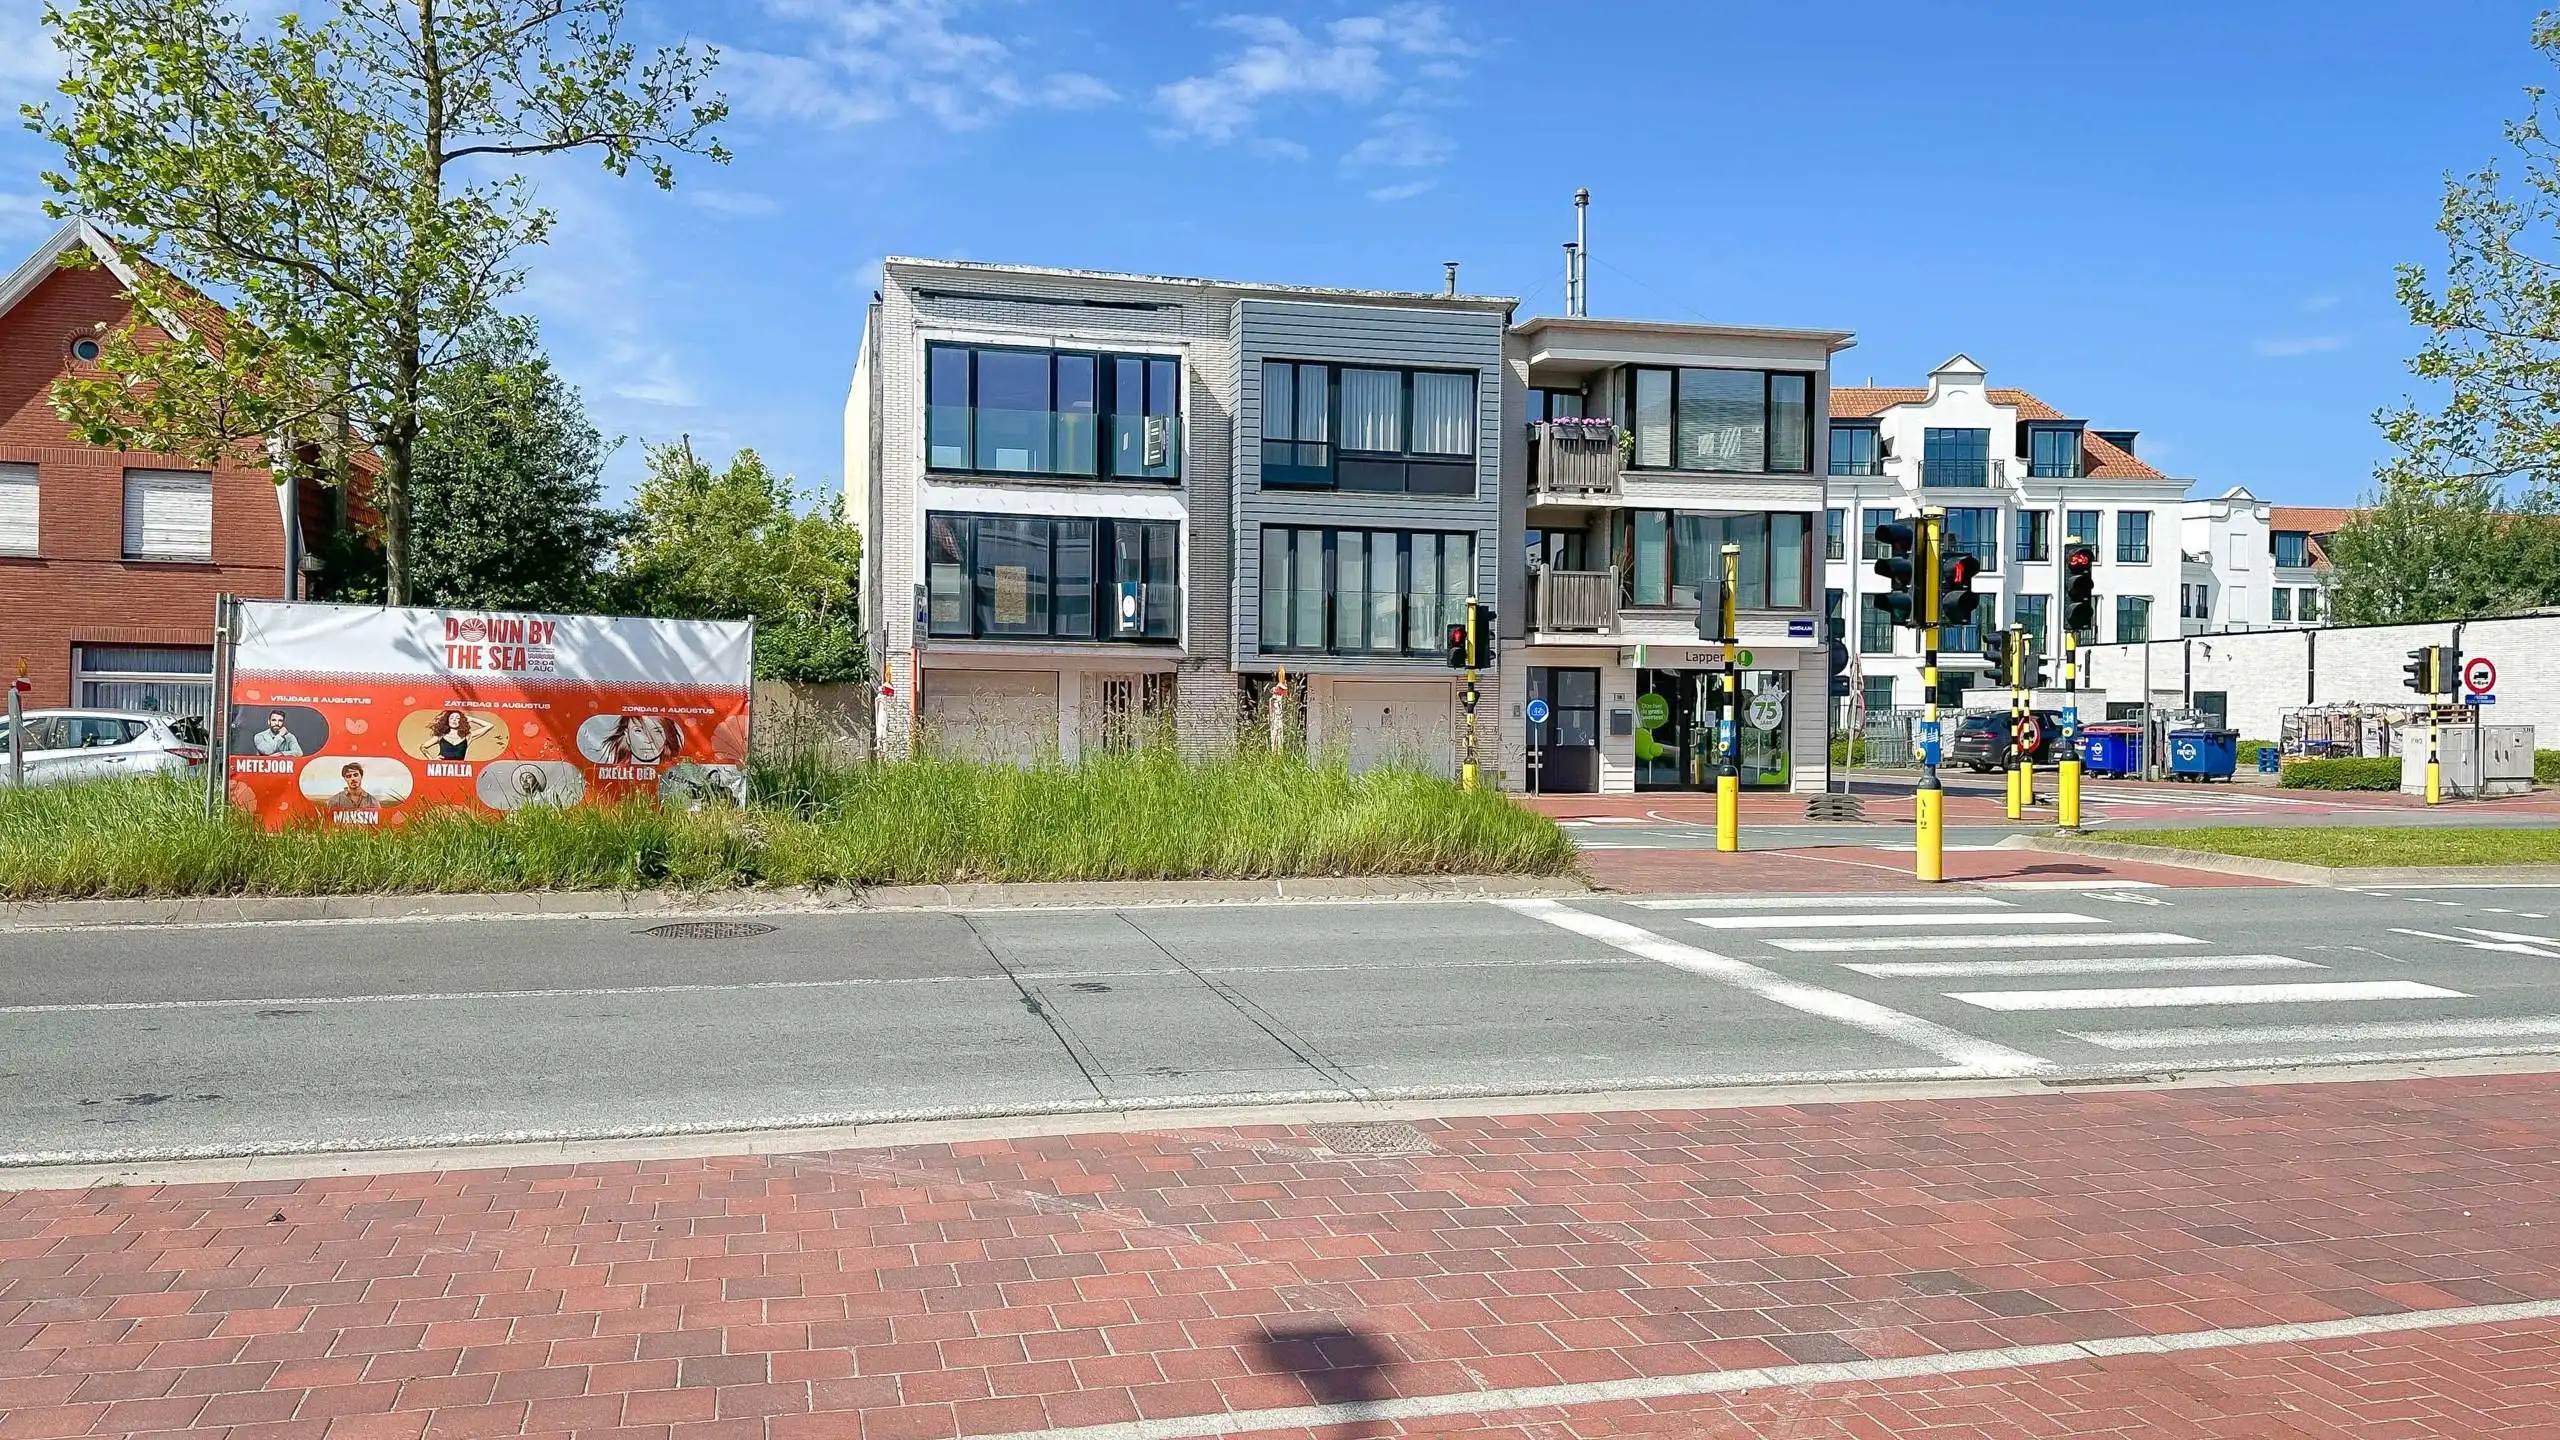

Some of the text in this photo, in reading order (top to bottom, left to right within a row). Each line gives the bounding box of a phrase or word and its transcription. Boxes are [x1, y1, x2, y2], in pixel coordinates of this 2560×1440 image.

[446, 617, 556, 645] DOWN BY
[445, 645, 527, 671] THE SEA
[270, 695, 311, 703] VRIJDAG
[320, 697, 372, 705] AUGUSTUS
[444, 700, 492, 708] ZATERDAG
[501, 702, 551, 710] AUGUSTUS
[668, 707, 715, 715] AUGUSTUS
[1754, 701, 1778, 720] 75
[236, 759, 294, 774] METEJOOR
[427, 763, 473, 777] NATALIA
